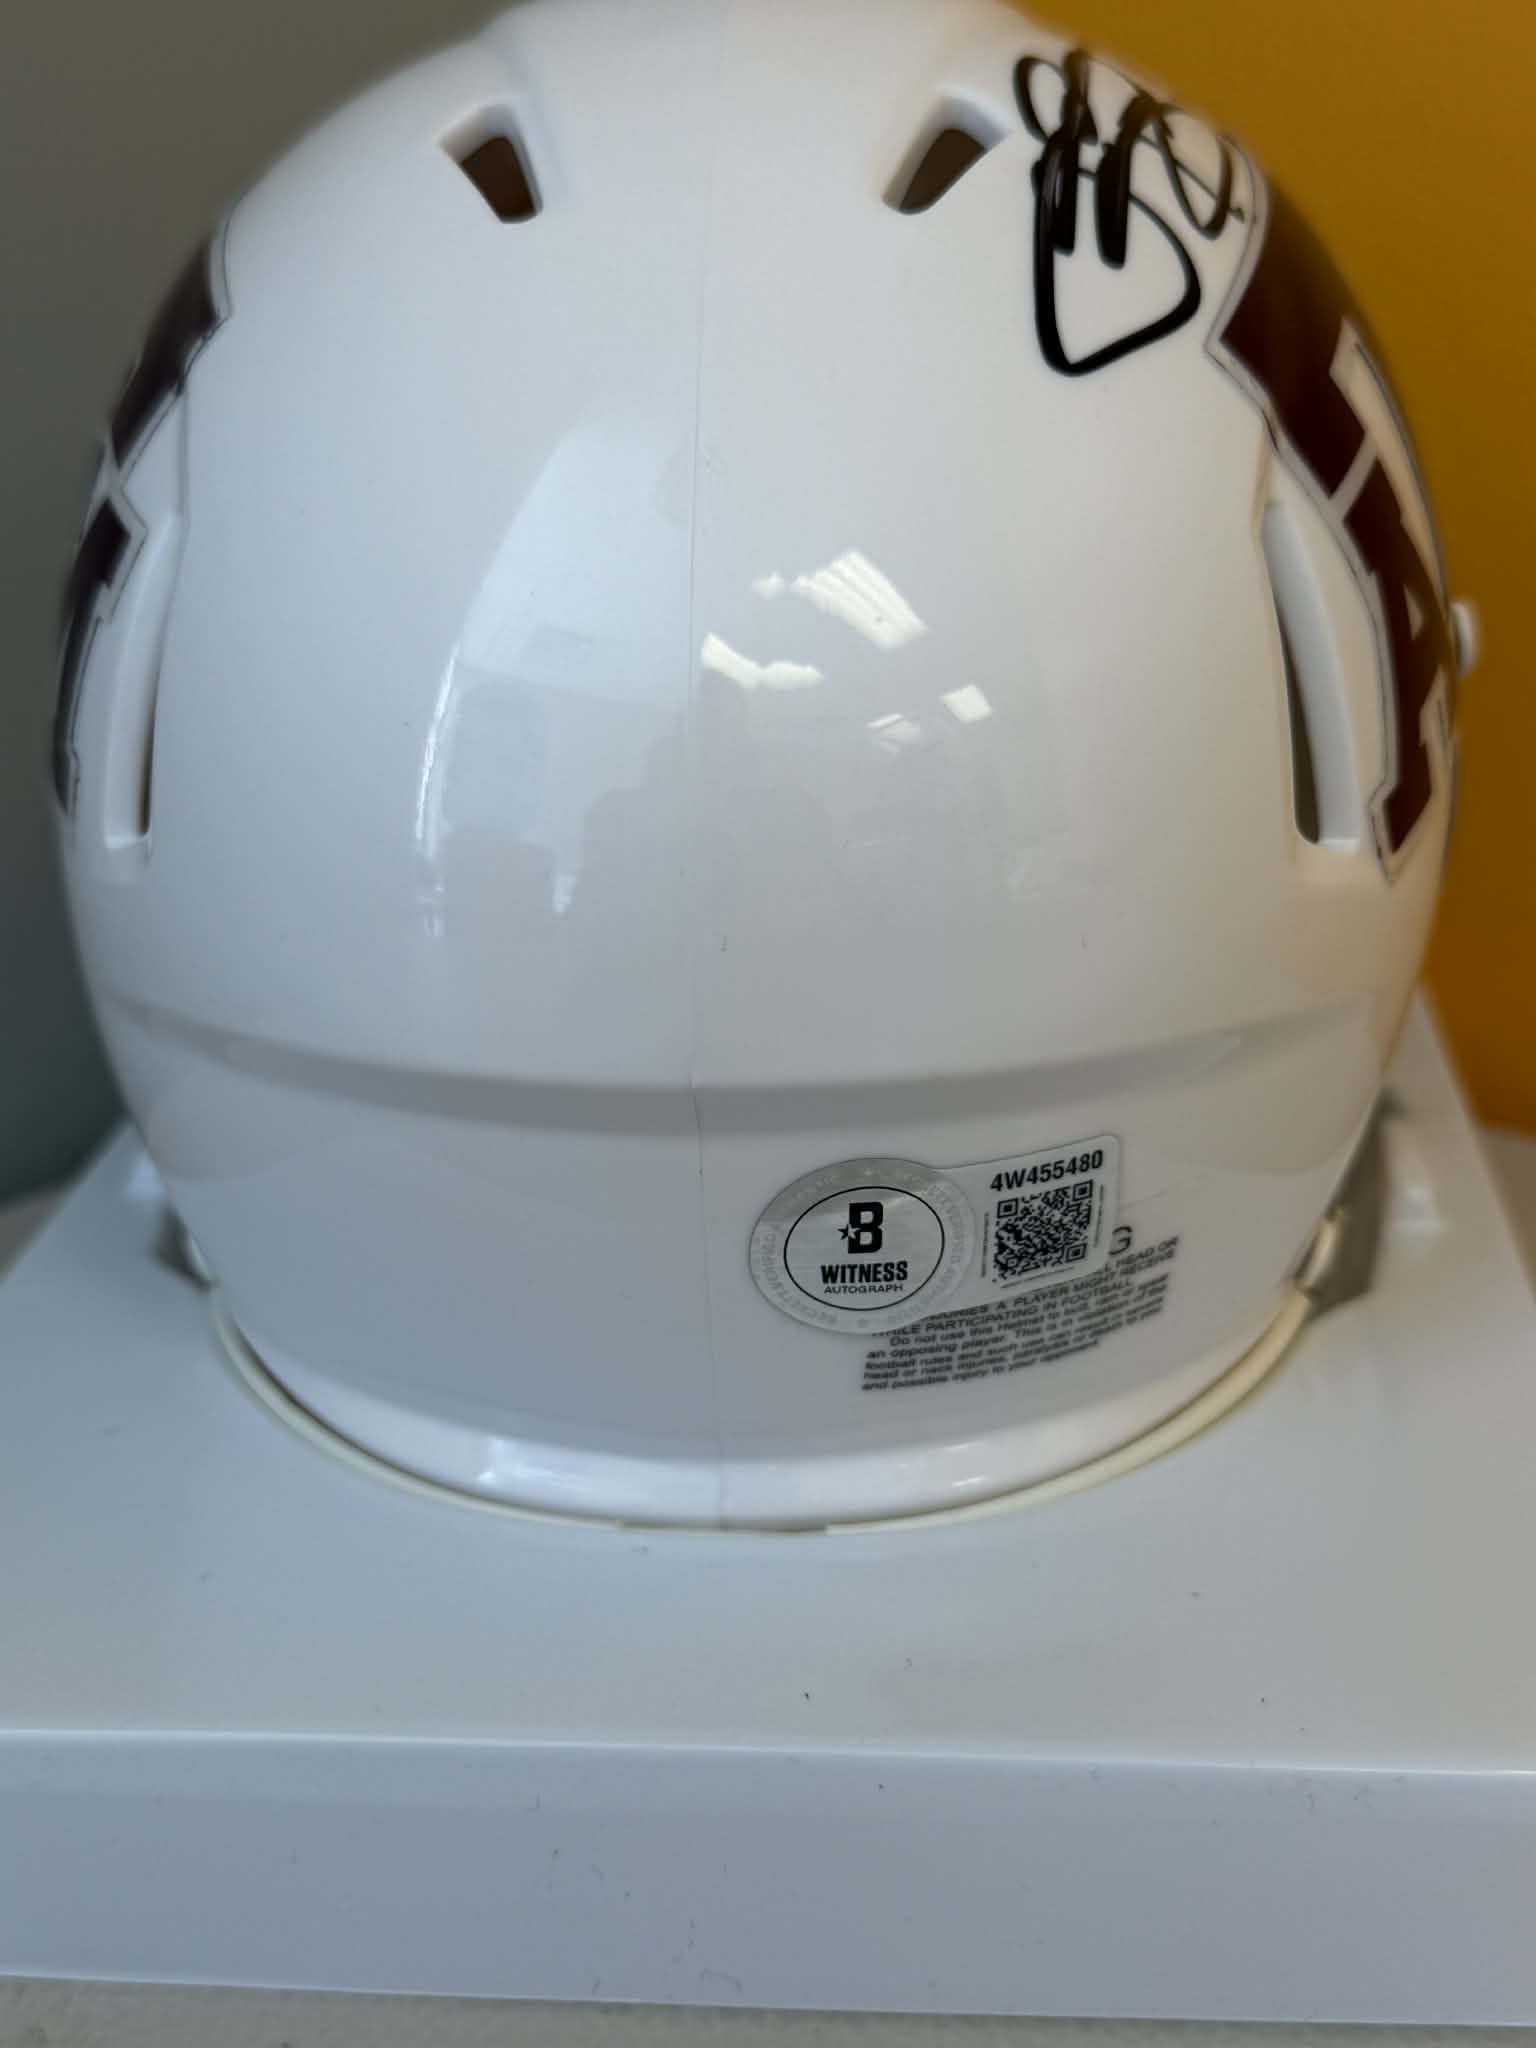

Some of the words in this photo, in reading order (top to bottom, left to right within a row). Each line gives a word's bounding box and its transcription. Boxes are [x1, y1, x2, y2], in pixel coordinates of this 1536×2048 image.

[990, 1149, 1103, 1191] 4W455480
[848, 1201, 884, 1254] B
[820, 1259, 909, 1284] WITNESS
[823, 1283, 904, 1295] AUTOGRAPH
[996, 1300, 1008, 1310] A
[1013, 1285, 1070, 1307] PLAYER
[1072, 1270, 1118, 1292] MIGHT
[925, 1306, 1039, 1332] PARTICIPATING
[1042, 1300, 1057, 1311] IN
[865, 1350, 887, 1359] an
[889, 1343, 958, 1359] opposing
[1015, 1327, 1042, 1339] This
[889, 1335, 911, 1347] Do
[914, 1333, 937, 1345] not
[940, 1330, 965, 1341] use
[969, 1325, 994, 1337] this
[863, 1369, 900, 1380] head
[865, 1359, 916, 1370] football
[919, 1356, 953, 1366] rules
[861, 1381, 889, 1391] and
